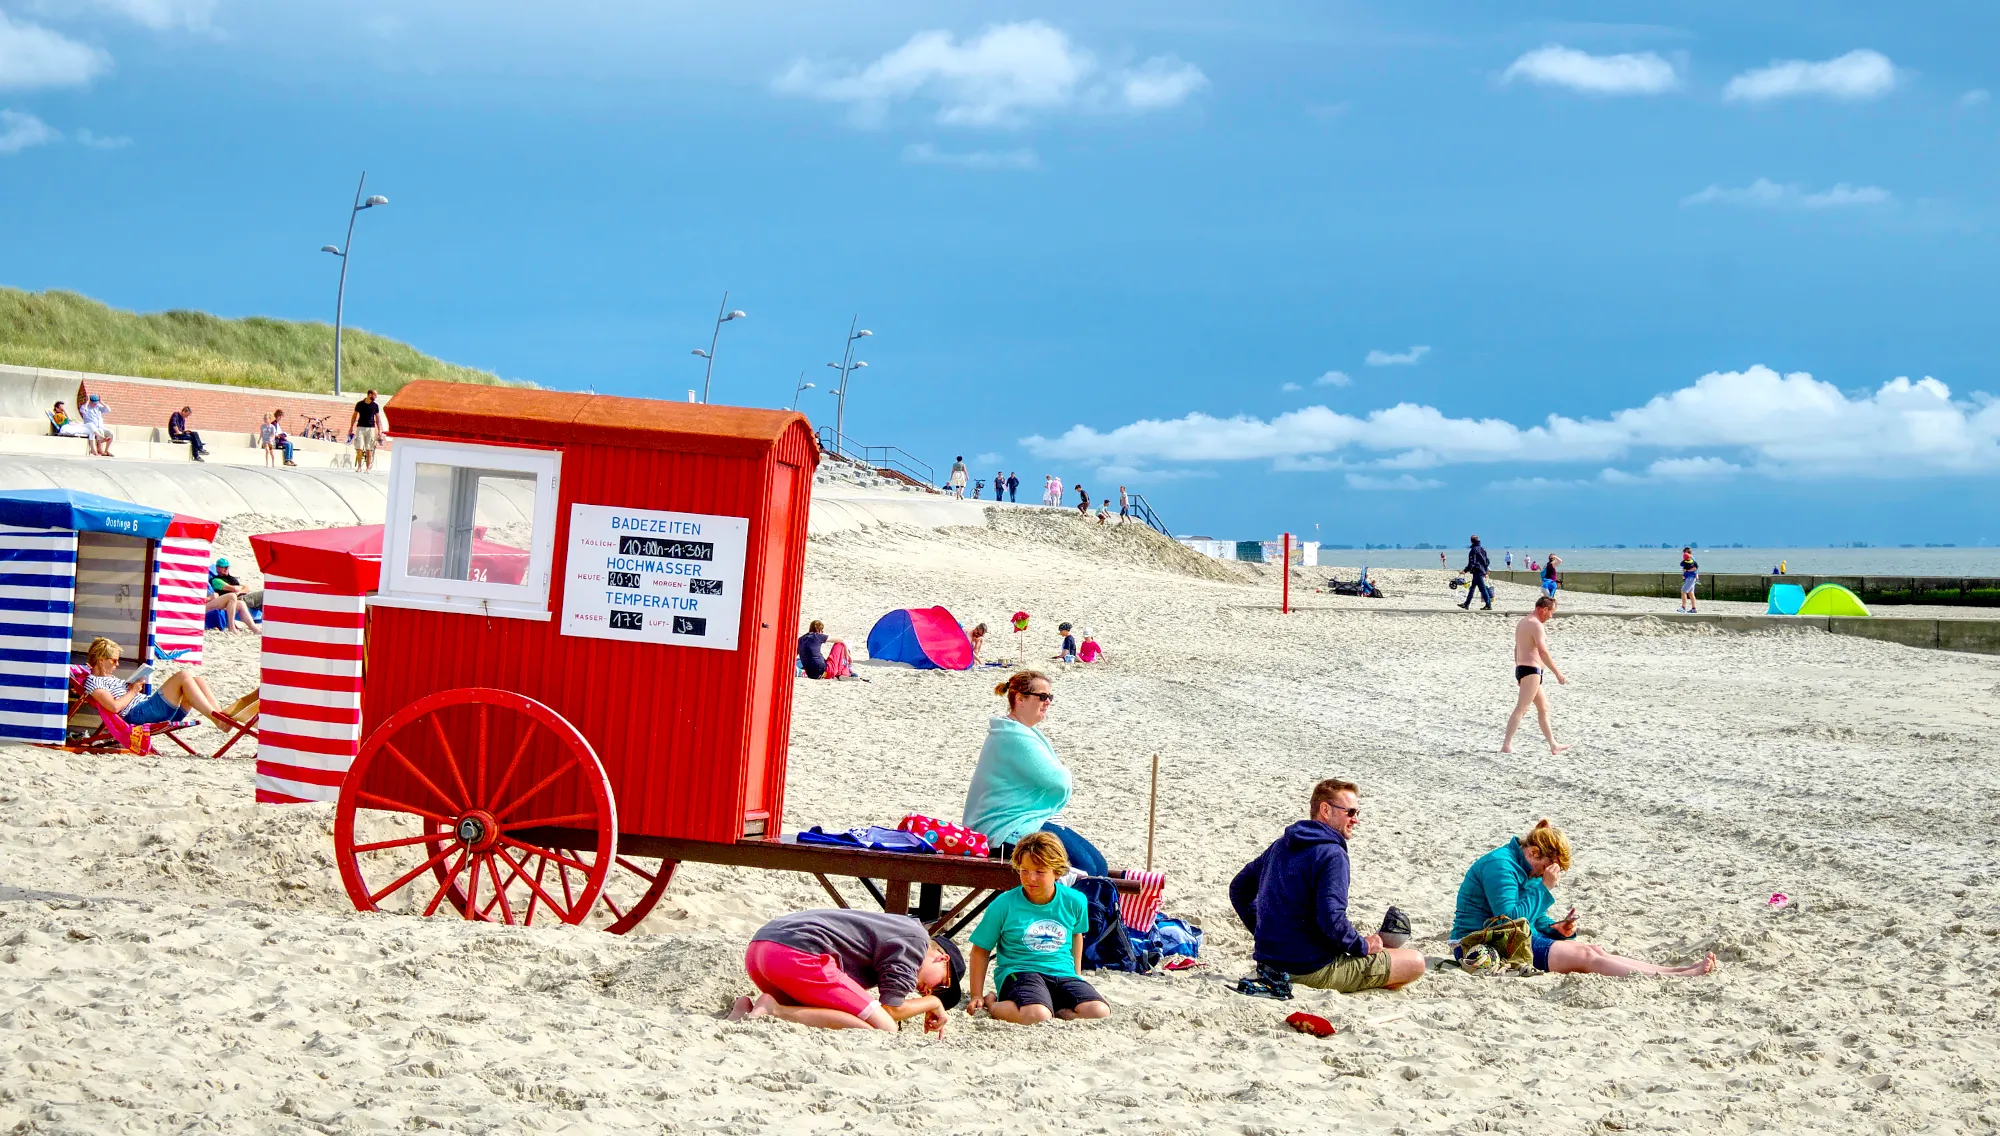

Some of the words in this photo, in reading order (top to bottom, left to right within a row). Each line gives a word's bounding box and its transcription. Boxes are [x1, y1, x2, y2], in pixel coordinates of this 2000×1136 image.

[132, 520, 138, 531] 6
[612, 517, 701, 535] BADEZEITEN
[607, 557, 702, 576] HOCHWASSER
[472, 568, 487, 582] 34
[609, 572, 641, 587] 20:20
[606, 592, 698, 611] TEMPERATUR
